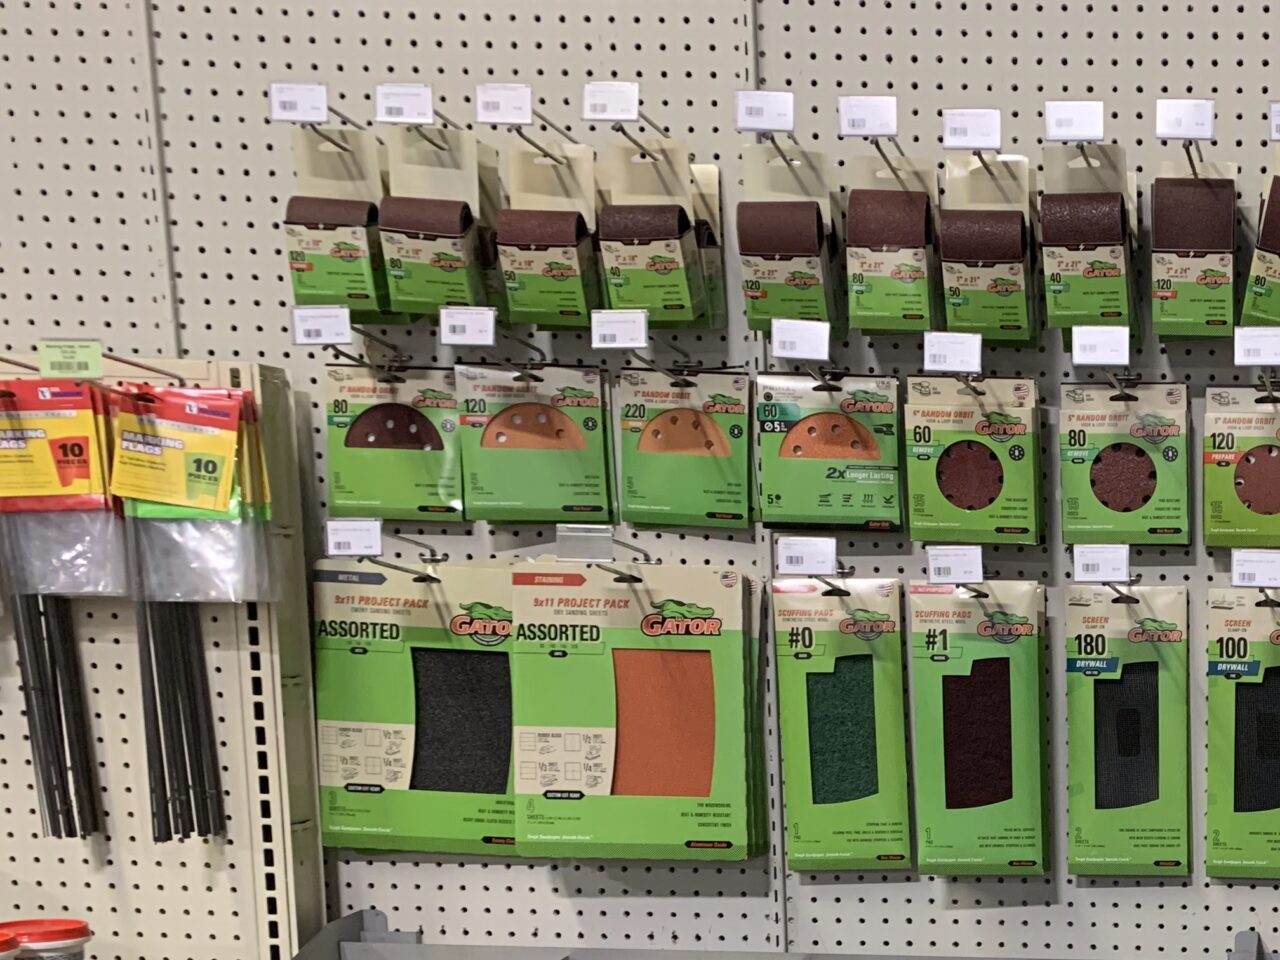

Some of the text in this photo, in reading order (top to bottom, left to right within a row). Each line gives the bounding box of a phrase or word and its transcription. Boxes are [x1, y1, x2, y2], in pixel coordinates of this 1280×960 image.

[745, 280, 760, 290] 120
[852, 273, 863, 284] 80
[1050, 273, 1061, 283] 40
[1156, 279, 1172, 290] 120
[1254, 276, 1266, 287] 80
[333, 400, 348, 414] 80
[464, 399, 486, 414] 120
[625, 405, 646, 419] 220
[764, 405, 777, 418] 60
[913, 425, 931, 443] 60
[1068, 430, 1086, 447] 80
[1210, 432, 1235, 450] 120
[58, 442, 83, 457] 10
[121, 441, 162, 455] FLAGS
[193, 458, 217, 474] 10
[335, 595, 430, 608] 9x11 PROJECT PACK
[534, 597, 631, 609] 9x11 PROJECT PACK
[952, 611, 972, 619] PADS
[1082, 616, 1109, 624] SCREEN
[318, 621, 400, 641] ASSORTED
[516, 623, 601, 642] ASSORTED
[640, 617, 723, 637] GATOR
[839, 619, 896, 634] GATOR
[788, 627, 813, 649] #0
[925, 629, 948, 651] #1
[1074, 634, 1106, 656] 180
[1217, 637, 1248, 659] 100
[1076, 660, 1107, 669] DRYWALL
[1217, 663, 1249, 671] DRYWALL
